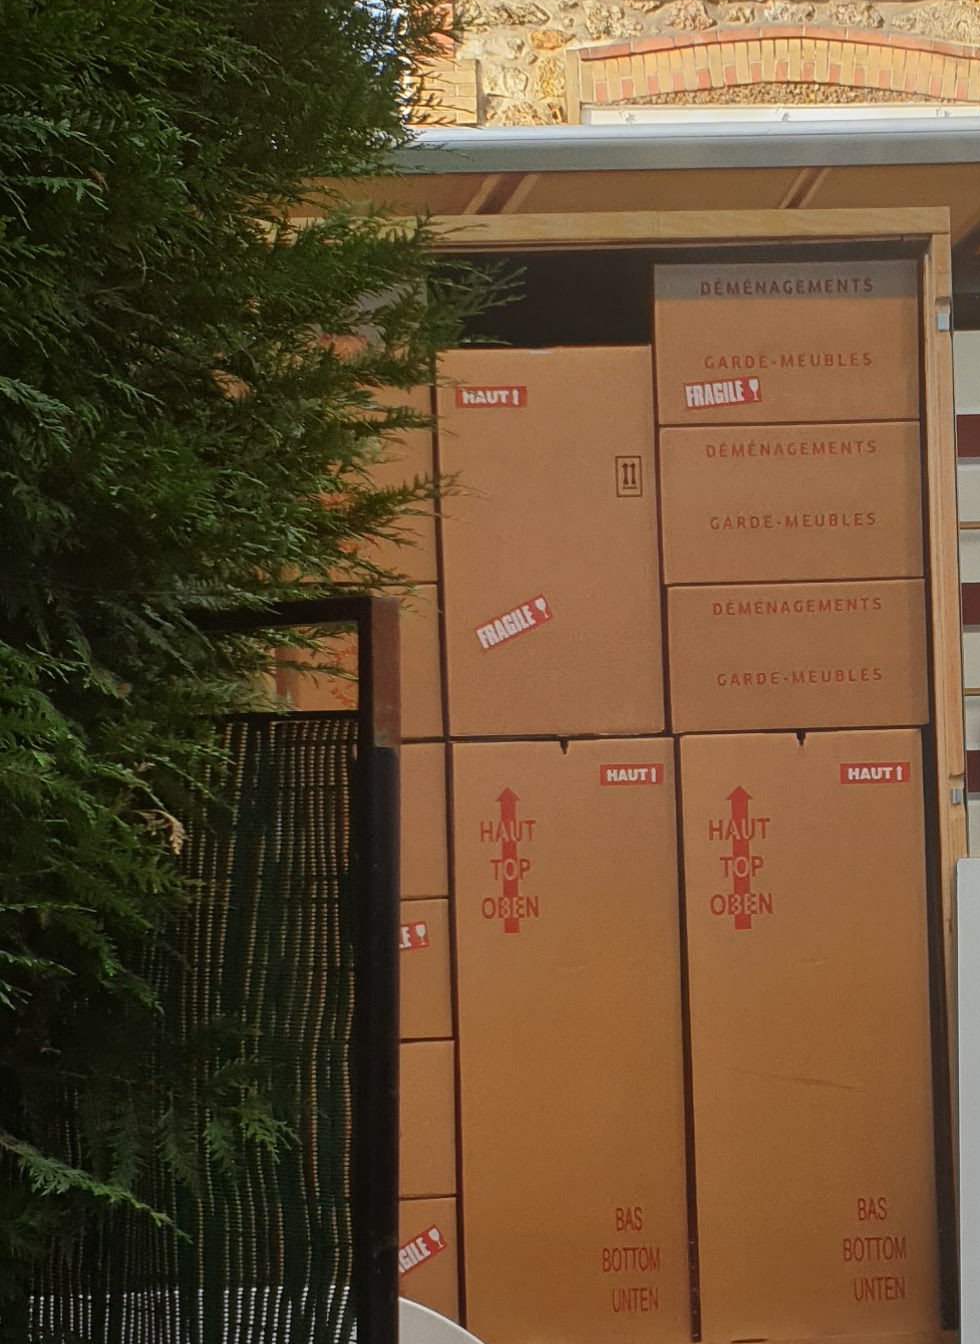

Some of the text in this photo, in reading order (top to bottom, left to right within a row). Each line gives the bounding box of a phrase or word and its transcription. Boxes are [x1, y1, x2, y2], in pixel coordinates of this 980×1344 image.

[700, 277, 874, 297] DÉMÉNAGEMENTS
[704, 352, 873, 370] GARDE-MEUBLES
[462, 388, 510, 404] HAUT
[685, 379, 745, 408] FRAGILE
[709, 512, 876, 531] GARDE-MEUBLES
[476, 605, 537, 649] FRAGILE
[716, 667, 883, 687] GARDE-MEUBLES
[606, 767, 649, 783] HAUT
[847, 766, 893, 781] HAUT
[479, 819, 536, 844] HAUT
[708, 817, 771, 842] HAUT
[490, 858, 531, 882] TOP
[719, 856, 764, 879] TOP
[480, 895, 541, 920] OBEN
[709, 892, 773, 917] OBEN
[615, 1206, 643, 1232] BAS
[857, 1196, 887, 1222] BAS
[398, 1236, 432, 1273] GILE
[602, 1246, 661, 1273] BOTTOM
[842, 1235, 907, 1263] BOTTOM
[611, 1287, 660, 1313] UNTEN
[853, 1276, 906, 1302] UNTEN
